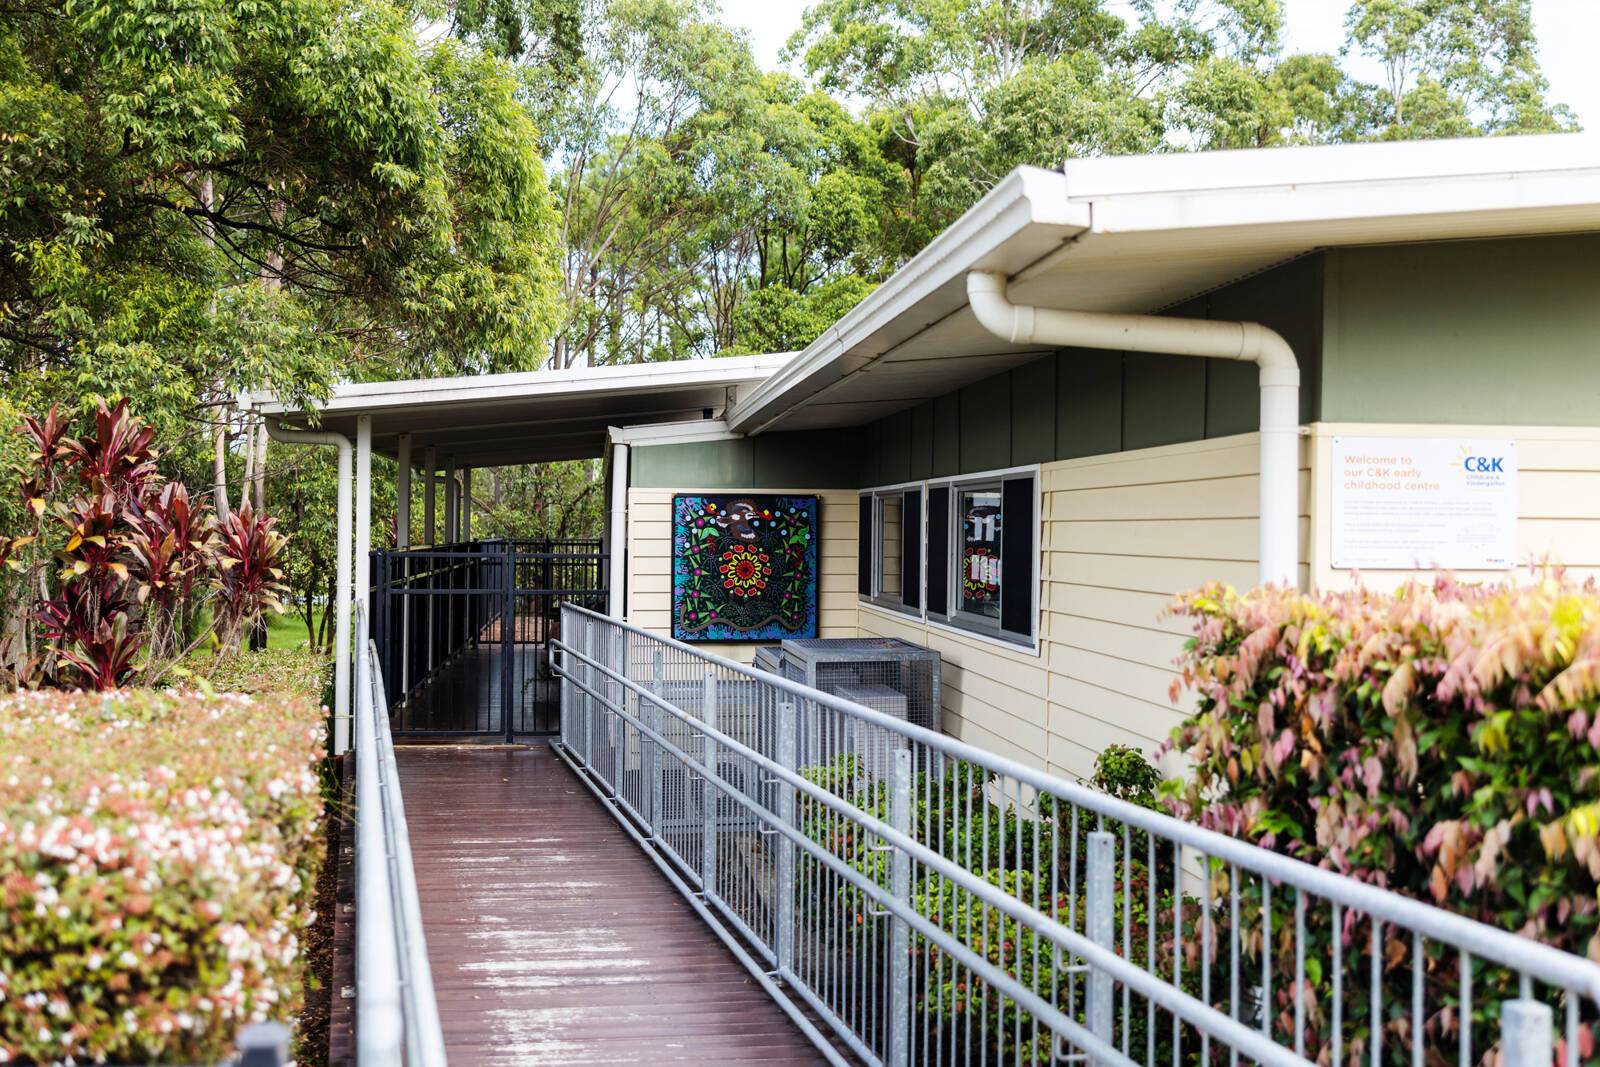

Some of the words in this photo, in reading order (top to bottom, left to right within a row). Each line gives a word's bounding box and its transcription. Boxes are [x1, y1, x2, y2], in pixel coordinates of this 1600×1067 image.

[1344, 455, 1397, 464] Welcome
[1401, 456, 1412, 464] to
[1464, 456, 1504, 472] C&K
[1344, 469, 1362, 477] our
[1367, 468, 1390, 477] C&K
[1394, 468, 1421, 478] early
[1344, 480, 1401, 490] childhood
[1405, 482, 1440, 490] centre
